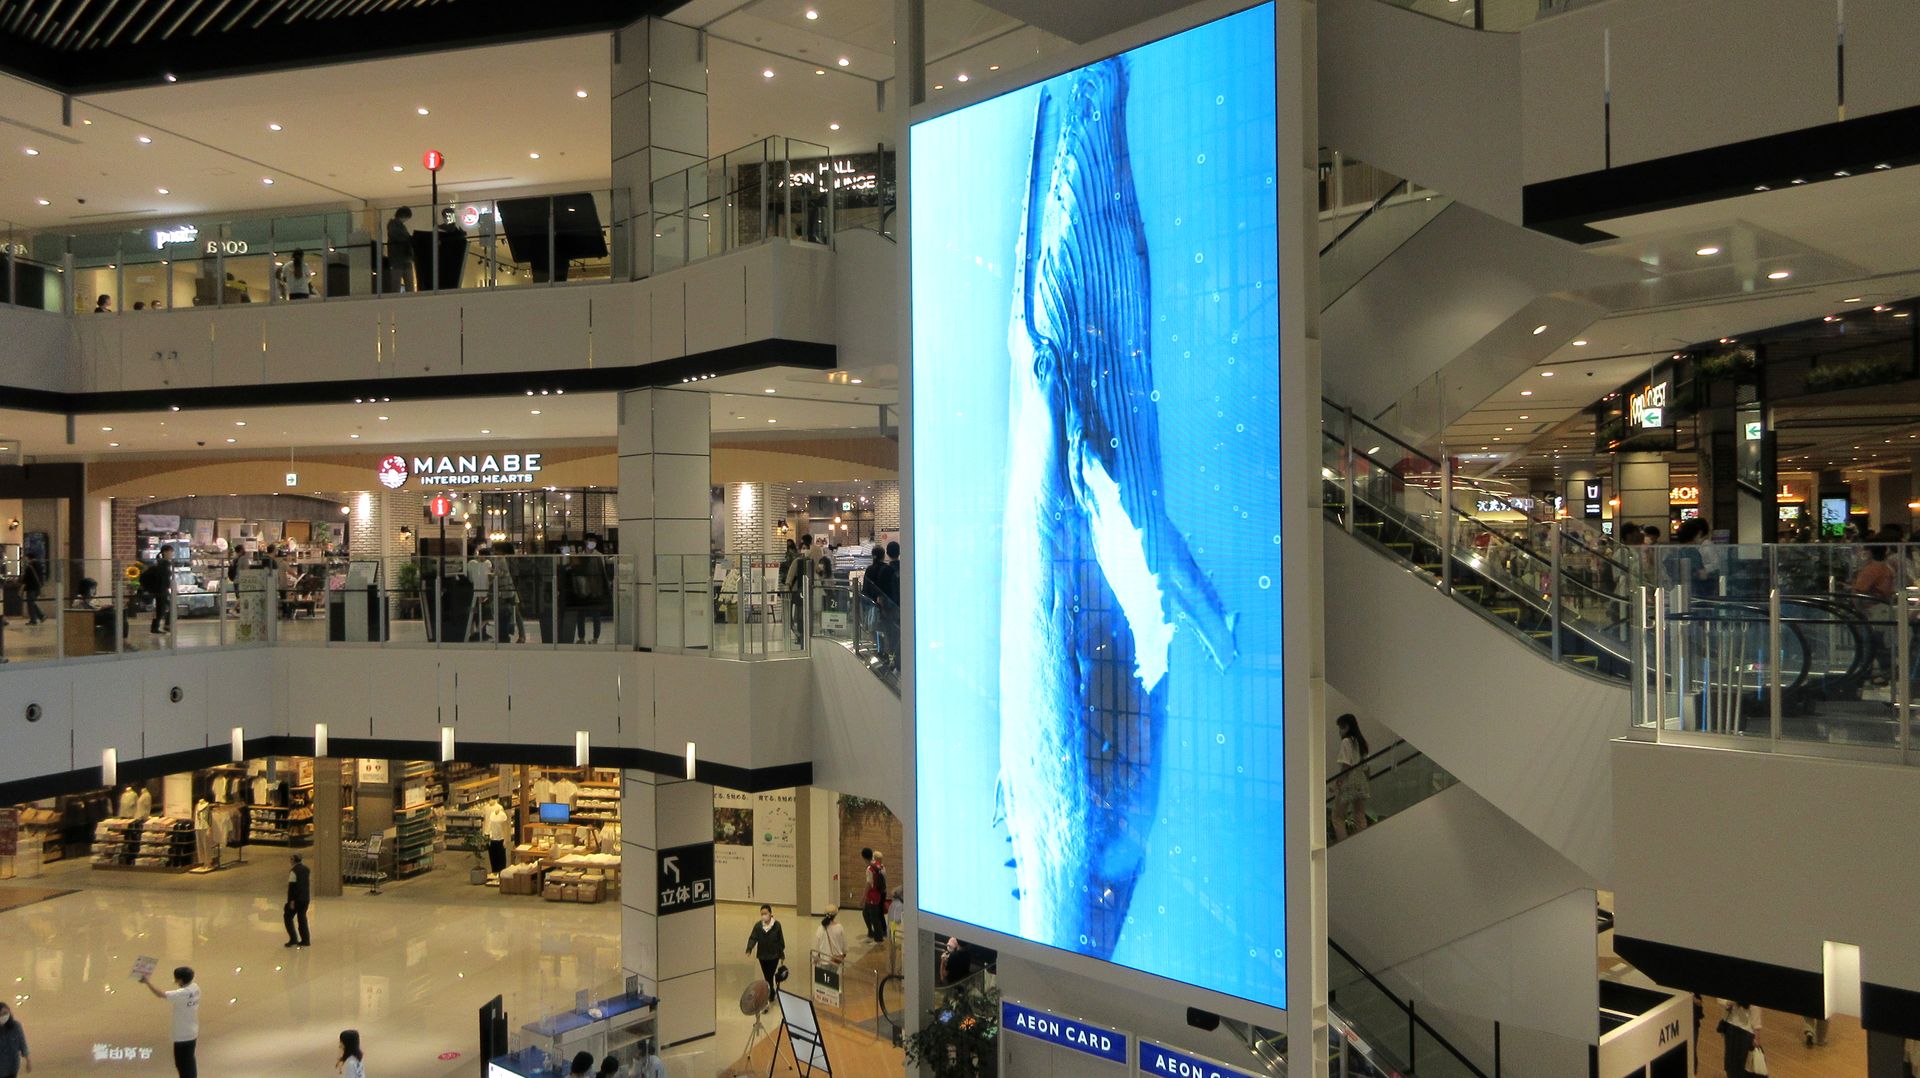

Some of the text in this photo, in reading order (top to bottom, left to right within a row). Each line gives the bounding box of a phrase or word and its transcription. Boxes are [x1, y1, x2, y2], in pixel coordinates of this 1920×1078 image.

[413, 453, 542, 474] MANABE
[420, 473, 533, 485] INTERIOR HEARTS
[660, 882, 705, 907] 立体 P
[1016, 1012, 1112, 1052] AEON CARD
[1658, 1019, 1680, 1047] ATM
[1155, 1054, 1203, 1078] AEON
